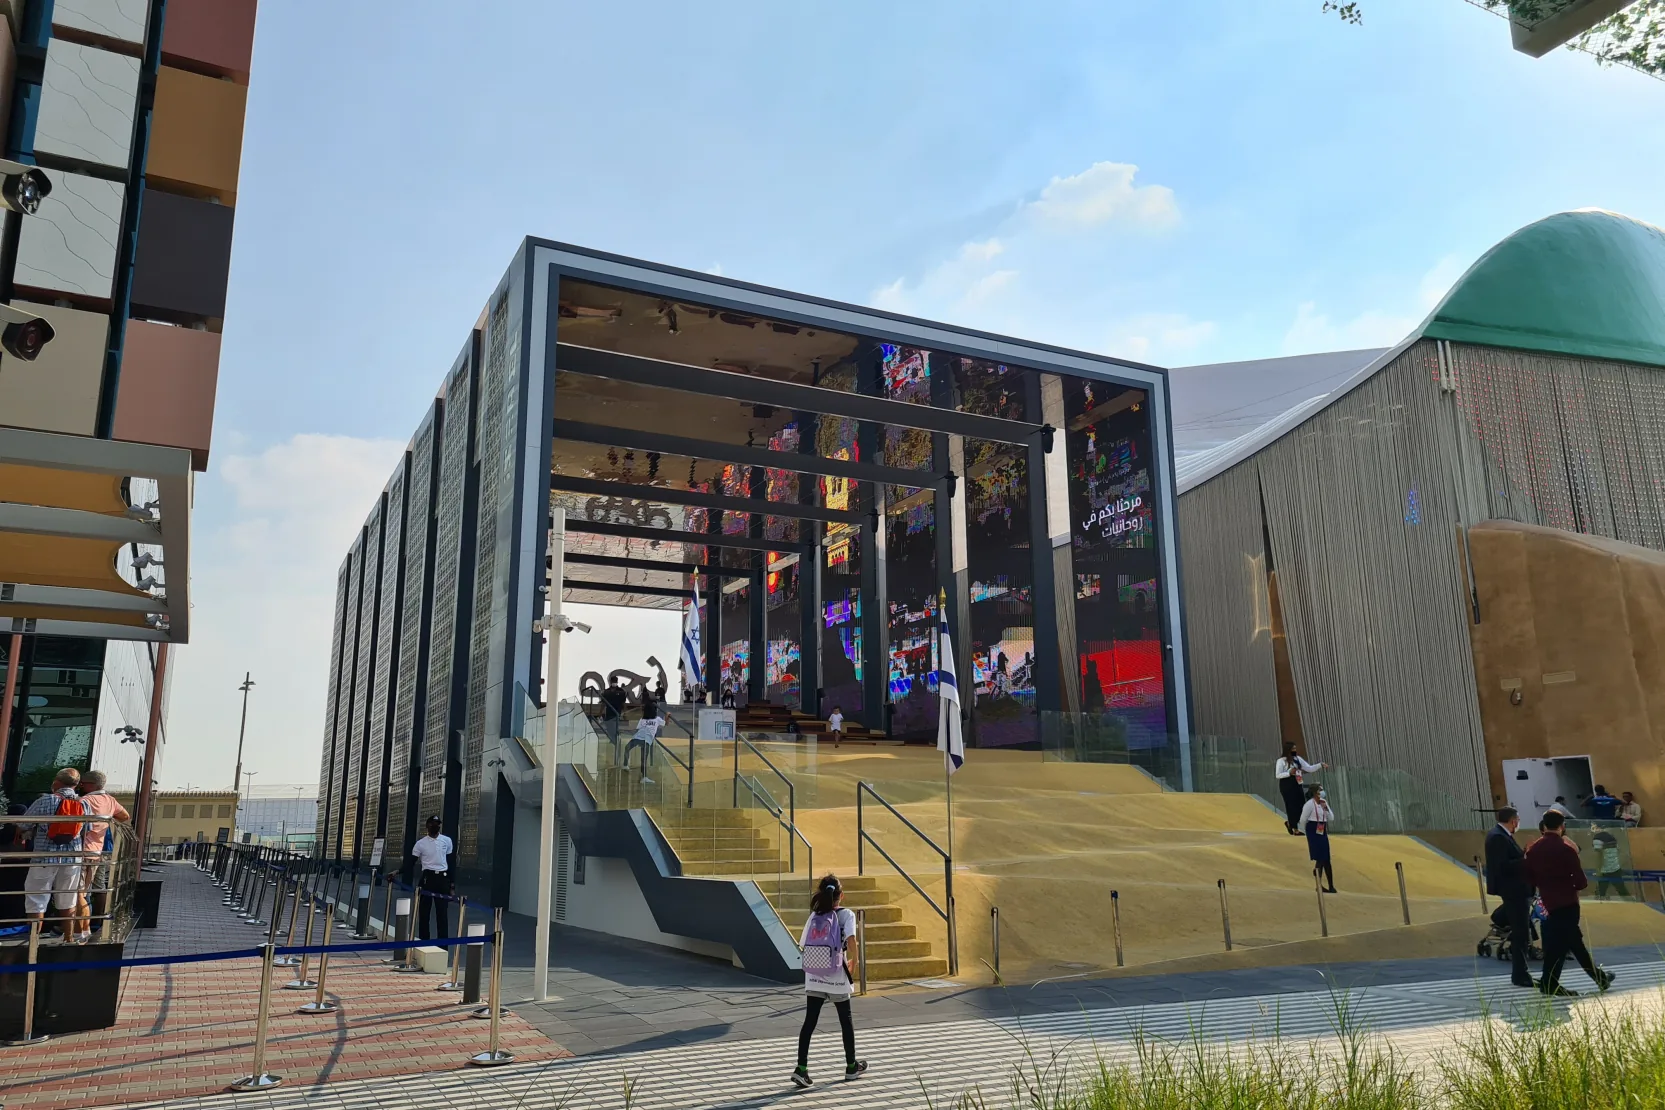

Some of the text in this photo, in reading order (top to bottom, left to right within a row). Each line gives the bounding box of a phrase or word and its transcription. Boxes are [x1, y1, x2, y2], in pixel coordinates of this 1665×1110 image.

[1082, 509, 1097, 531] في
[1098, 503, 1115, 526] بكم
[1101, 516, 1143, 538] روحانيات
